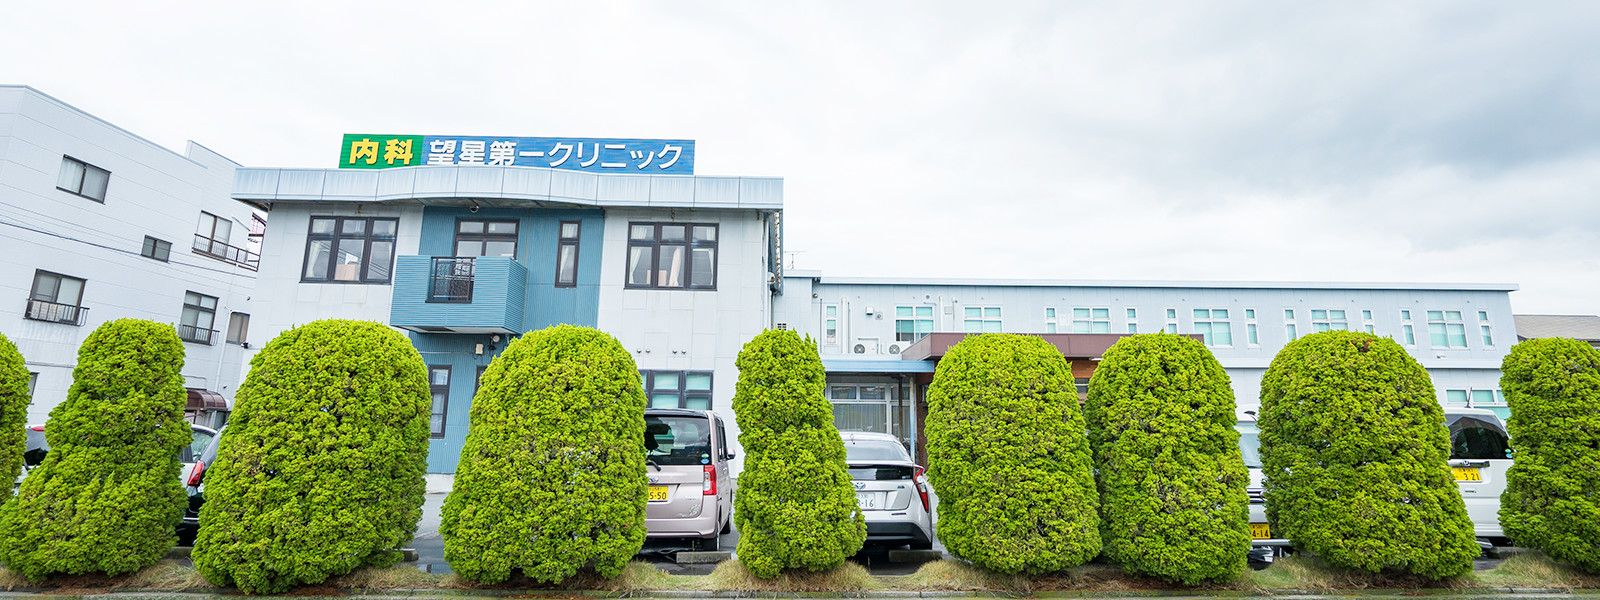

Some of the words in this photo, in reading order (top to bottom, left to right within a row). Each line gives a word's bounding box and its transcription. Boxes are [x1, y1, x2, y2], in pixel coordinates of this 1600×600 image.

[348, 138, 414, 165] 内科
[427, 139, 683, 170] 望星第一クリニック
